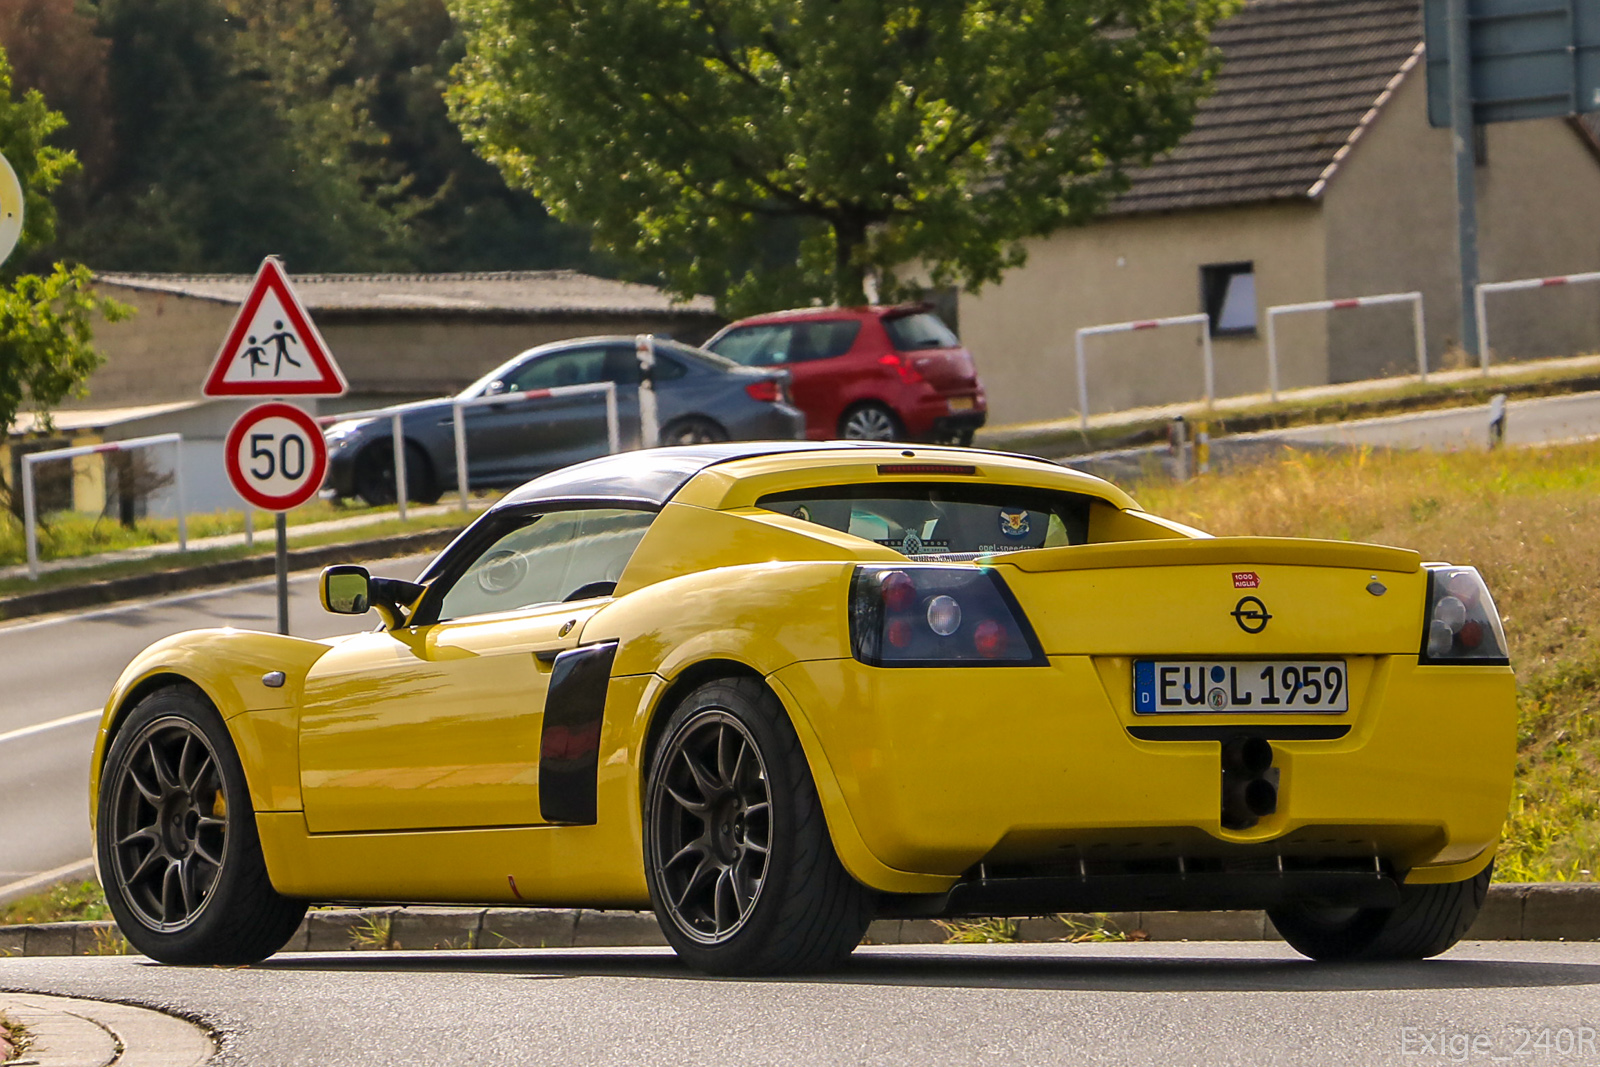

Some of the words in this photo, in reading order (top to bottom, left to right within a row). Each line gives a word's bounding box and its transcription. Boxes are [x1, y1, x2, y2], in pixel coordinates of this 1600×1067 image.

[250, 433, 305, 480] 50
[1141, 692, 1150, 703] D
[1160, 666, 1206, 706] EU
[1260, 666, 1343, 705] 1959
